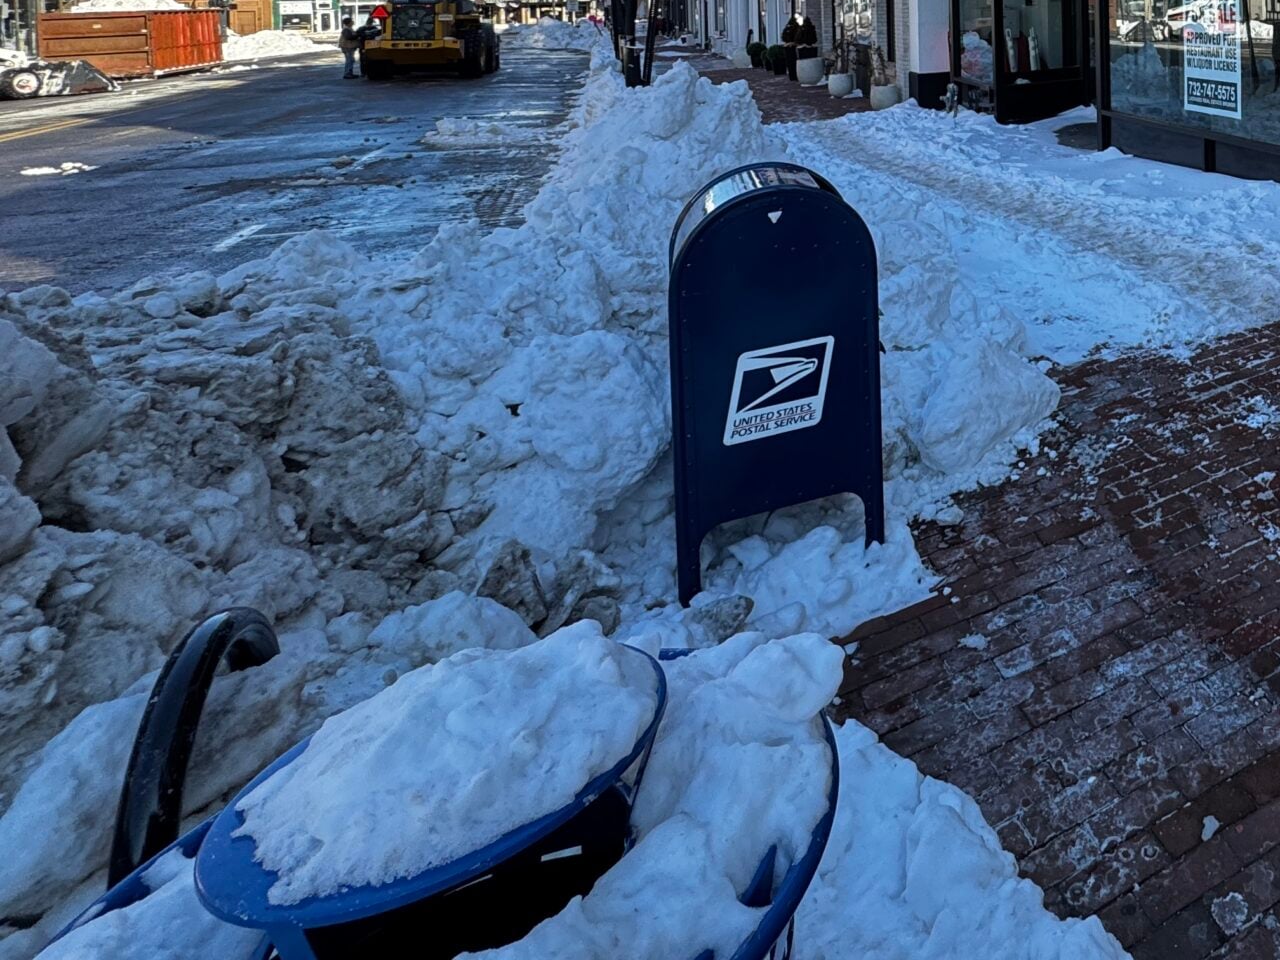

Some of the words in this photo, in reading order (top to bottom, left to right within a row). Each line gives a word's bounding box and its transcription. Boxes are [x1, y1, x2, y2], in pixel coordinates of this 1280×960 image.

[1186, 31, 1221, 46] APPROVED
[1186, 46, 1223, 59] RESTAURANT
[1224, 47, 1238, 60] USE
[1213, 59, 1238, 73] LICENSE
[1188, 80, 1236, 102] 732-747-5575
[733, 411, 775, 428] UNITED
[776, 402, 813, 418] STATES
[730, 424, 771, 439] POSTAL
[774, 413, 817, 429] SERVICE
